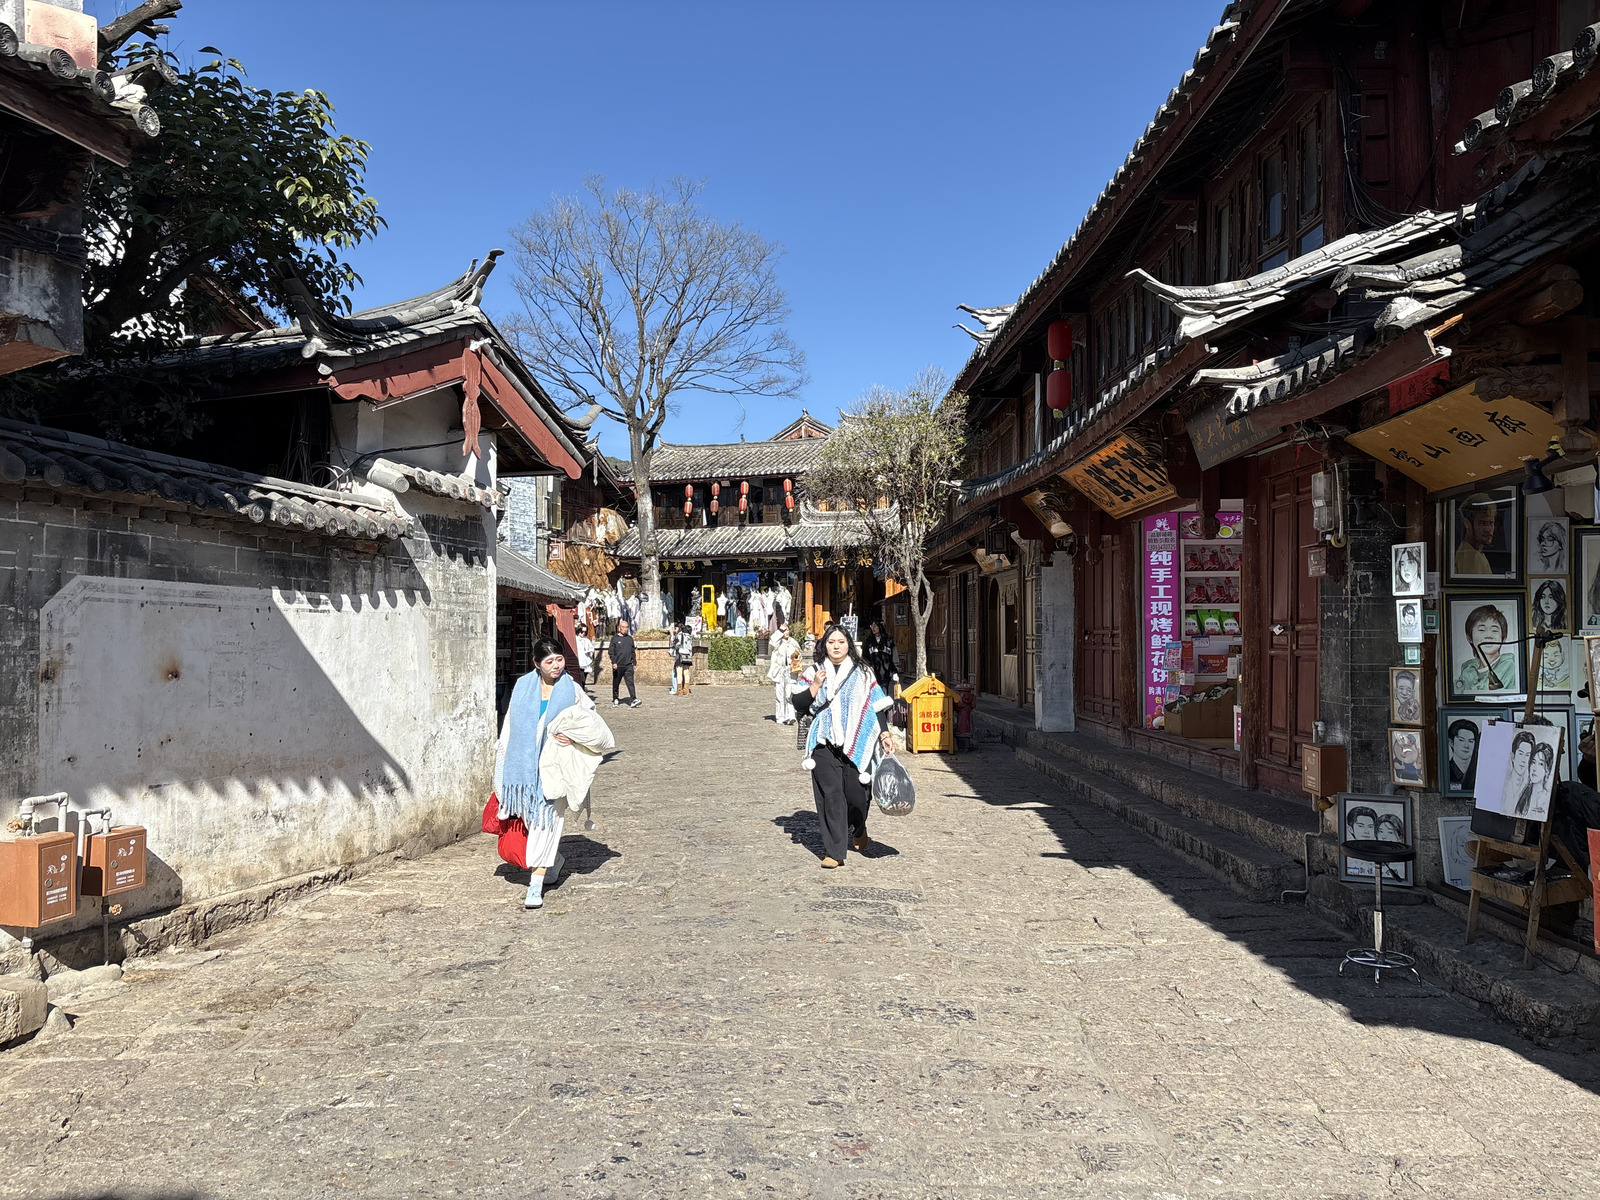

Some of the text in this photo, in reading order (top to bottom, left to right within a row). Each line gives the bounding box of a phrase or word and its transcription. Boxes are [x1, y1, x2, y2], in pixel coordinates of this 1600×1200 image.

[1389, 411, 1534, 468] 雪山画廊
[932, 723, 945, 732] 119
